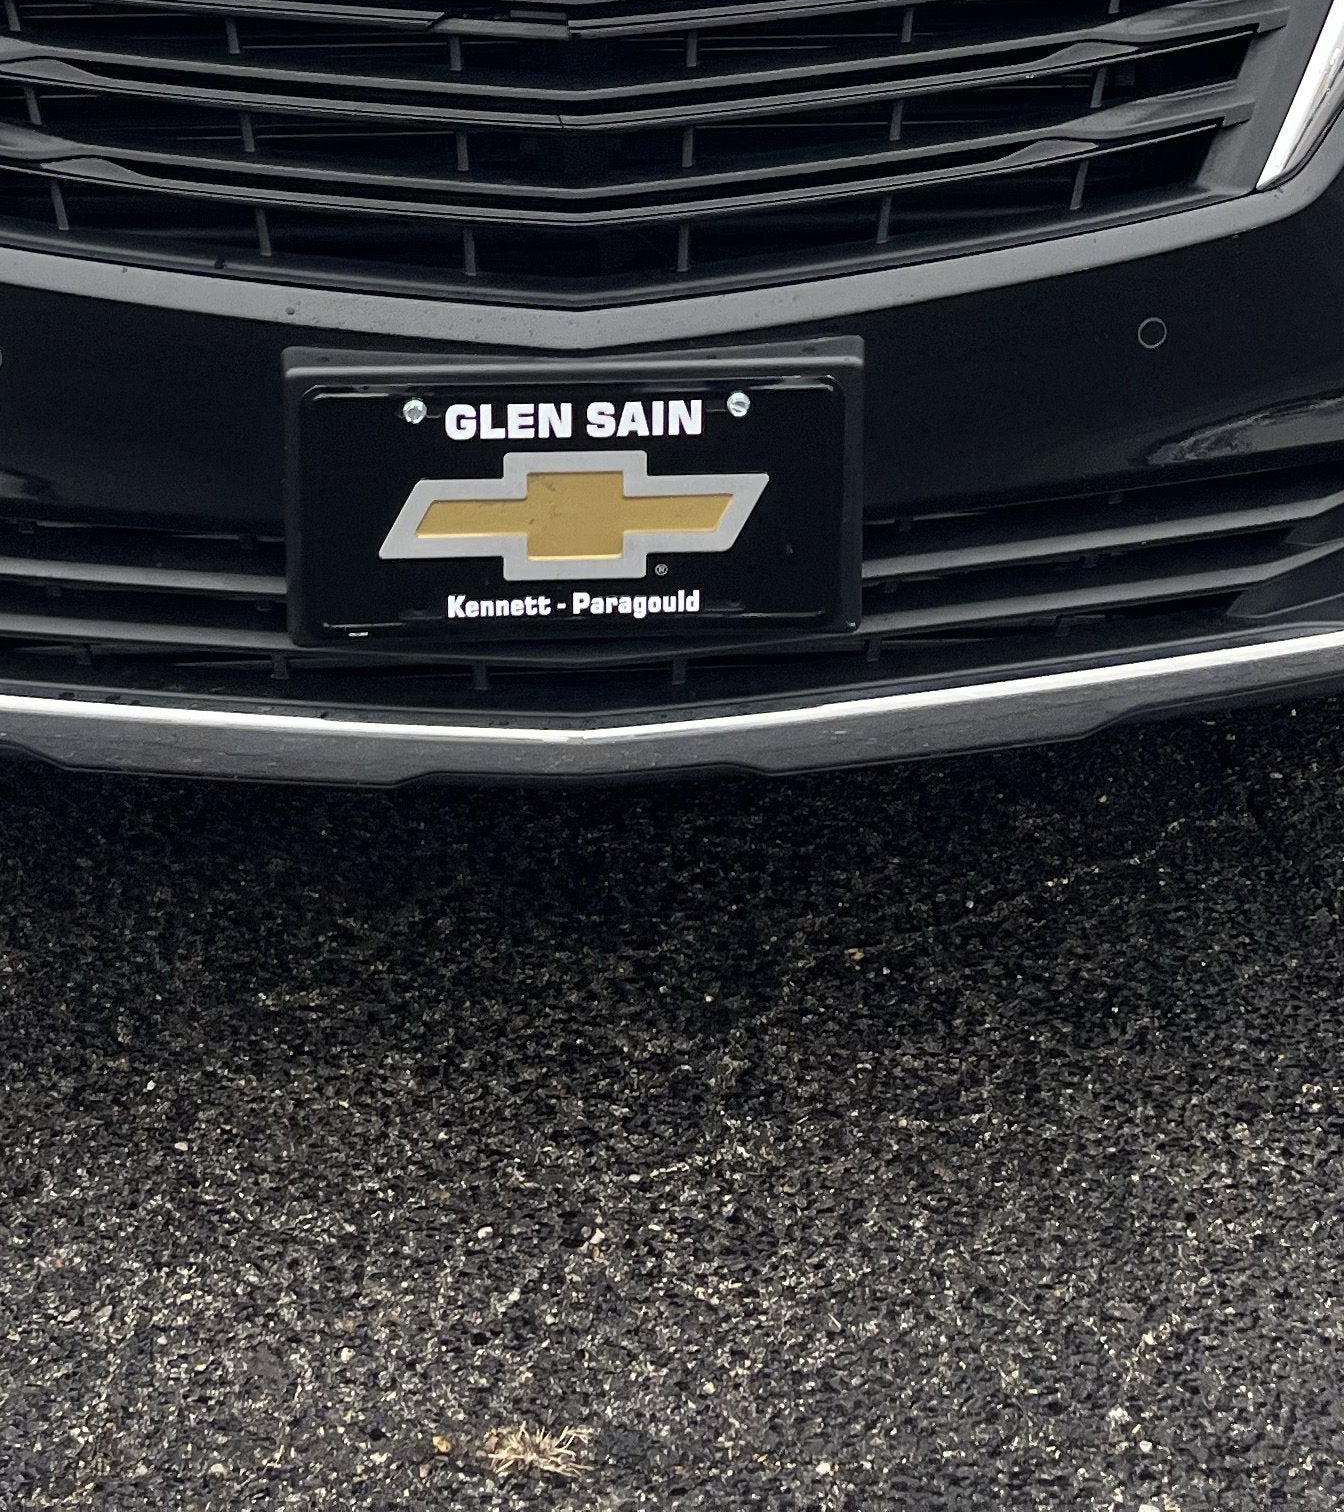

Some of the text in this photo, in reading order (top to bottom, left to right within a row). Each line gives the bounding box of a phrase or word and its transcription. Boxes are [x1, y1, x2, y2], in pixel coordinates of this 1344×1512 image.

[444, 399, 703, 441] GLEN SAIN
[447, 594, 552, 618] Kennett
[571, 589, 701, 619] Paragould
